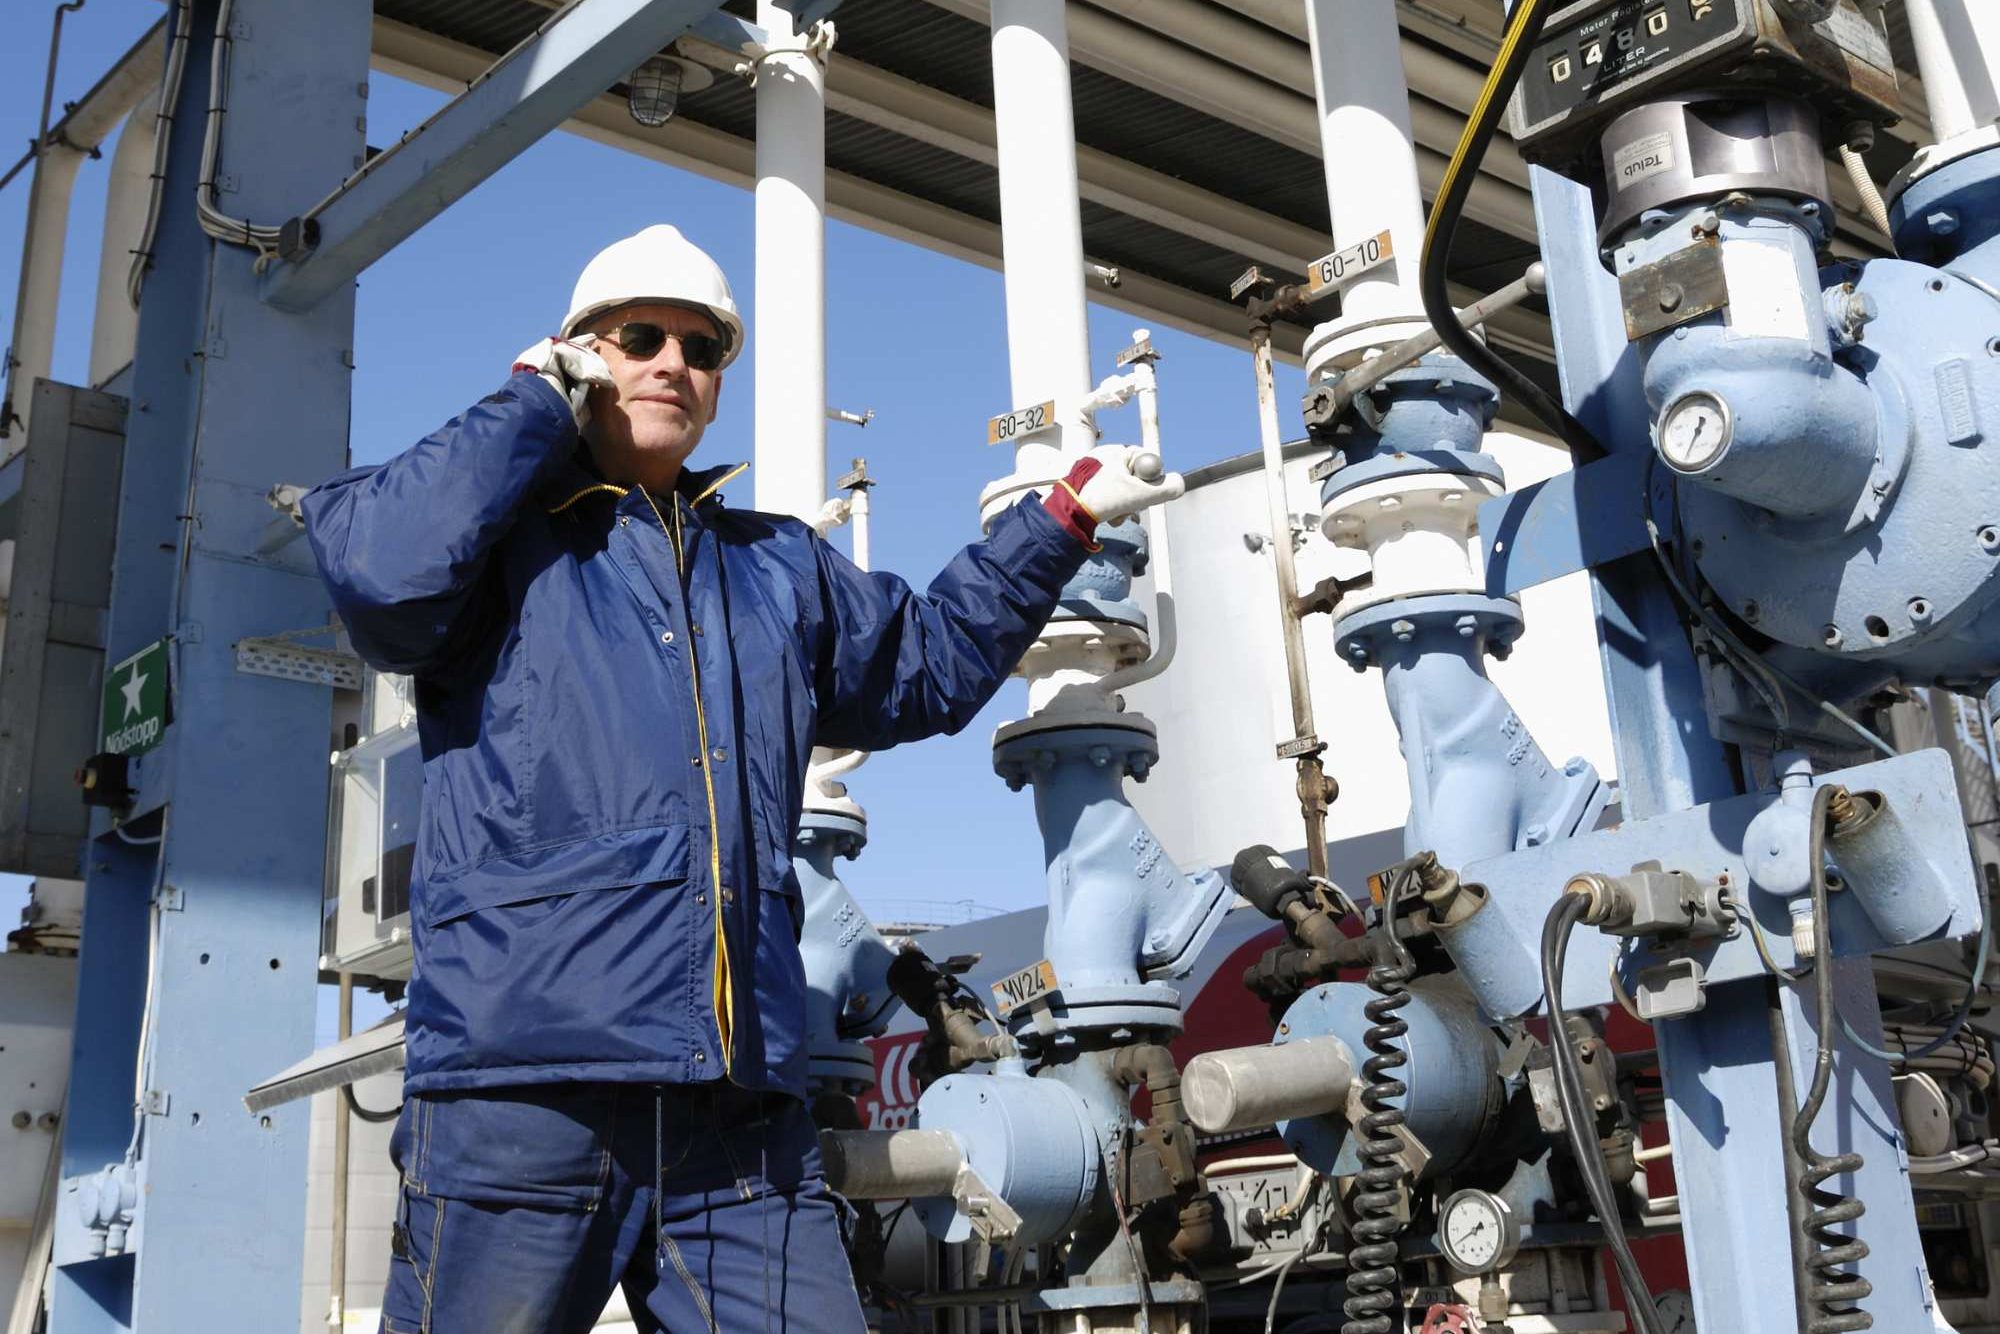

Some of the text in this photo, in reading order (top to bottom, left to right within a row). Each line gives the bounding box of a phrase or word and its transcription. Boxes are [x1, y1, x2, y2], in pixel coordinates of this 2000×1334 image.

[1580, 18, 1608, 37] Meter
[1603, 46, 1646, 73] LITER
[1624, 154, 1663, 177] Telub
[105, 716, 159, 755] Nödstopp
[1002, 966, 1047, 1007] MV24
